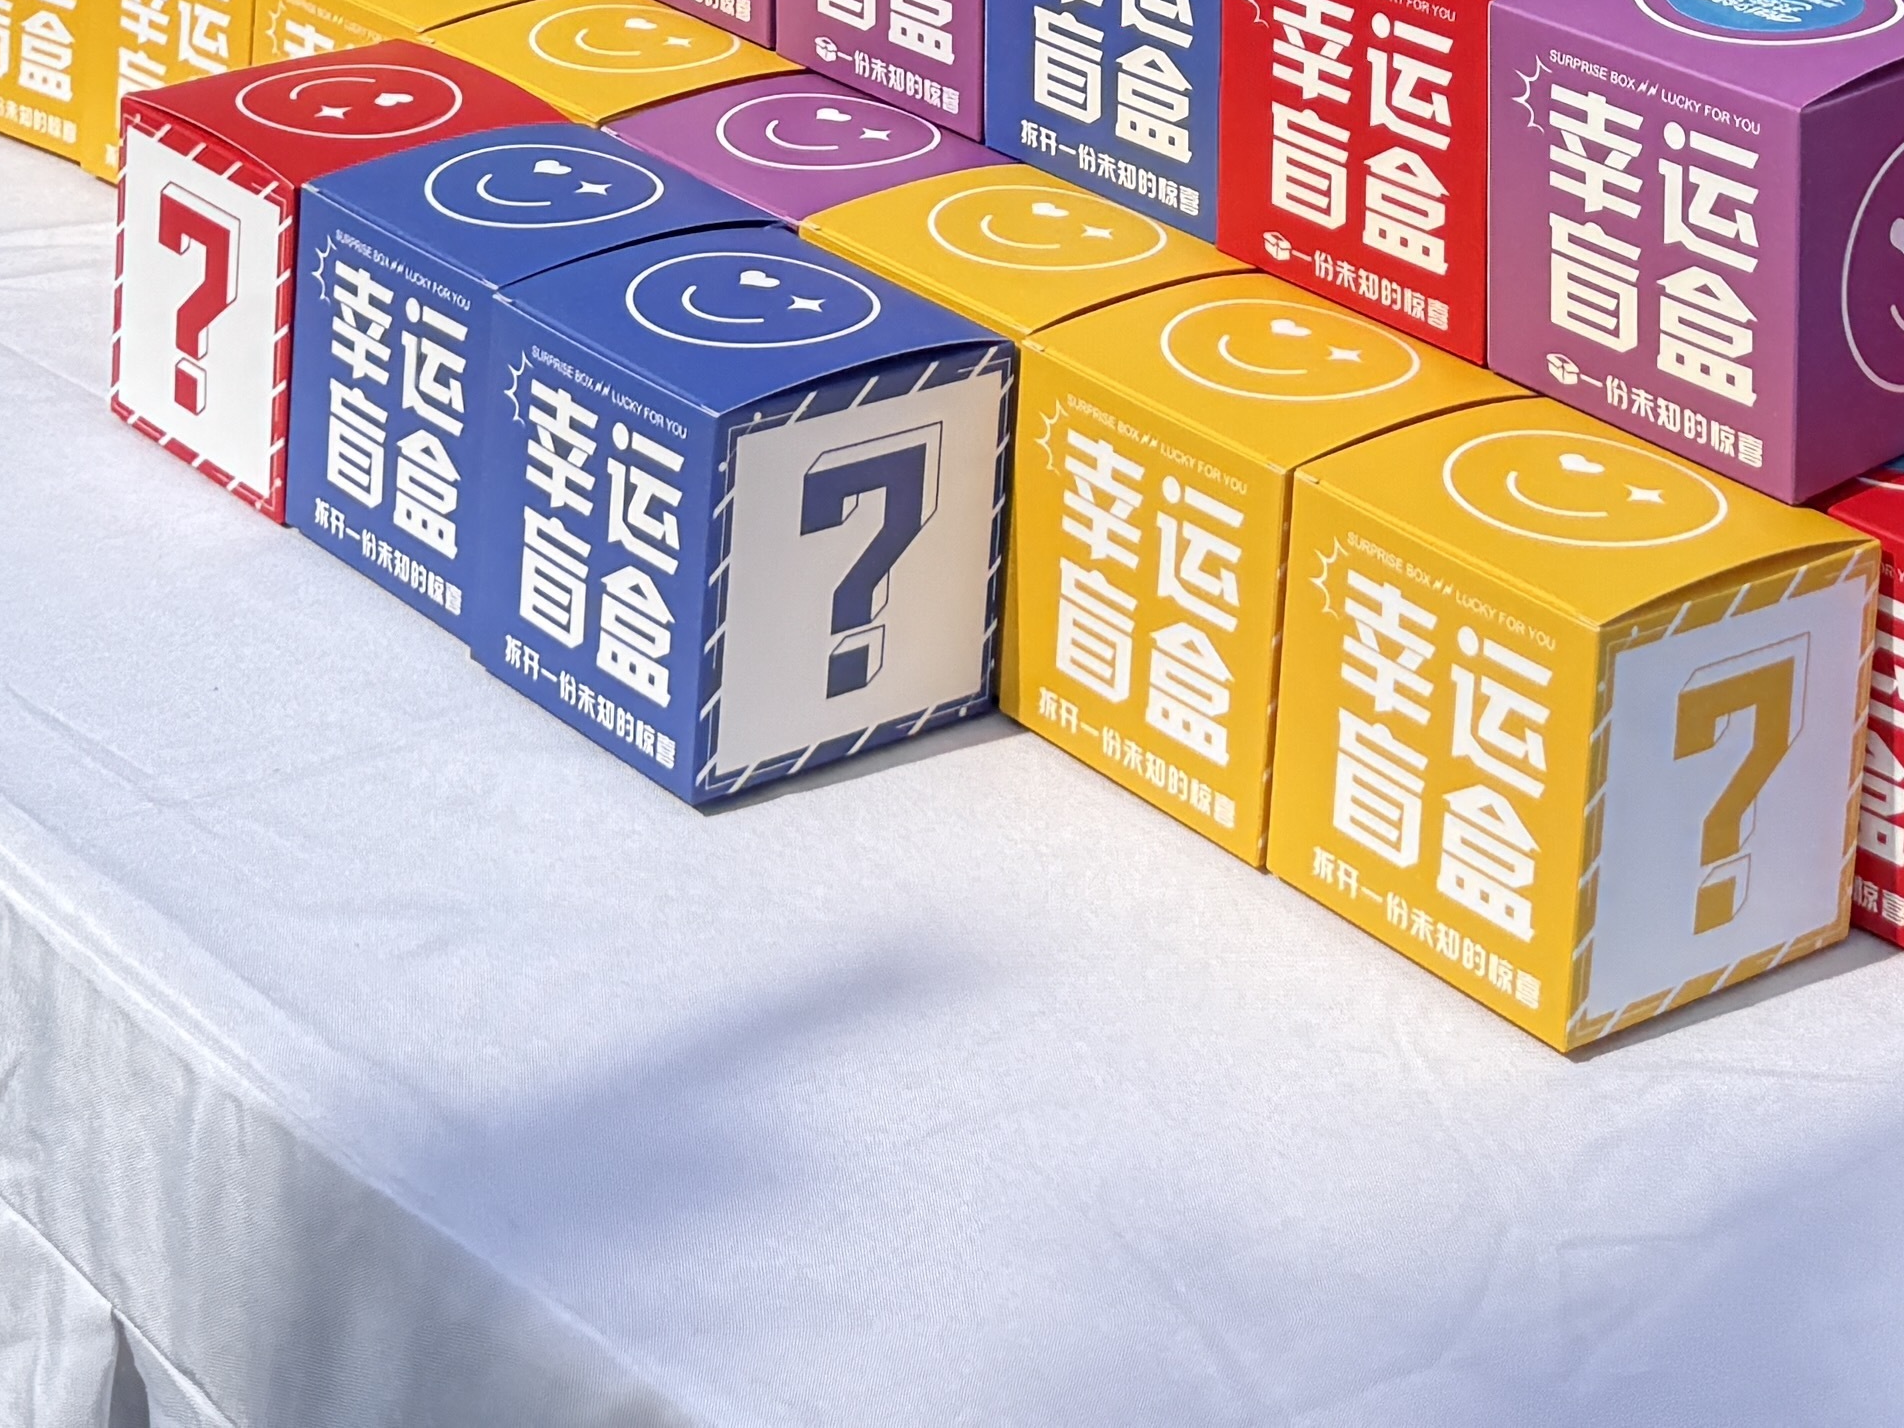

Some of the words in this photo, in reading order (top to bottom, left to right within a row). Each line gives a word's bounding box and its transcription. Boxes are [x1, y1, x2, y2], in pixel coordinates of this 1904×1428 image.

[836, 50, 958, 113] 一份未知的惊喜
[1034, 6, 1192, 165] 盲盒
[1430, 2, 1456, 23] YOU
[1548, 47, 1608, 82] SURPRISE
[1609, 70, 1636, 92] BOX
[1659, 87, 1701, 115] LUCKY
[1703, 103, 1731, 125] FOR
[1732, 113, 1761, 137] YOU
[1021, 120, 1201, 218] 拆开一份未知的惊喜
[1271, 101, 1448, 274] 盲盒
[1549, 84, 1758, 272] 幸运
[158, 181, 241, 417] ?
[331, 260, 467, 436] 幸运
[1291, 250, 1448, 330] 一份未知的惊喜
[1549, 212, 1756, 406] 盲盒
[327, 378, 460, 558] 盲盒
[526, 379, 683, 574] 幸运
[531, 344, 575, 381] SURPRISE
[575, 369, 595, 391] BOX
[611, 388, 643, 416] LUCKY
[643, 405, 664, 428] FOR
[664, 417, 686, 441] YOU
[1580, 374, 1762, 467] 一份未知的惊喜
[314, 498, 461, 615] 拆开一份未知的惊喜
[519, 506, 674, 707] 盲盒
[799, 421, 943, 700] ?
[1062, 430, 1243, 631] 幸运
[1348, 530, 1407, 575] SURPRISE
[1407, 562, 1434, 589] BOX
[1456, 587, 1498, 622] LUCKY
[1498, 610, 1527, 638] FOR
[1527, 625, 1556, 653] YOU
[505, 634, 675, 768] 拆开一份未知的惊喜
[1056, 558, 1231, 766] 盲盒
[1341, 570, 1551, 797] 幸运
[1039, 688, 1235, 828] 拆开一份未知的惊喜
[1333, 709, 1537, 941] 盲盒
[1674, 630, 1811, 936] ?
[1313, 847, 1540, 1009] 拆开一份未知的惊喜
